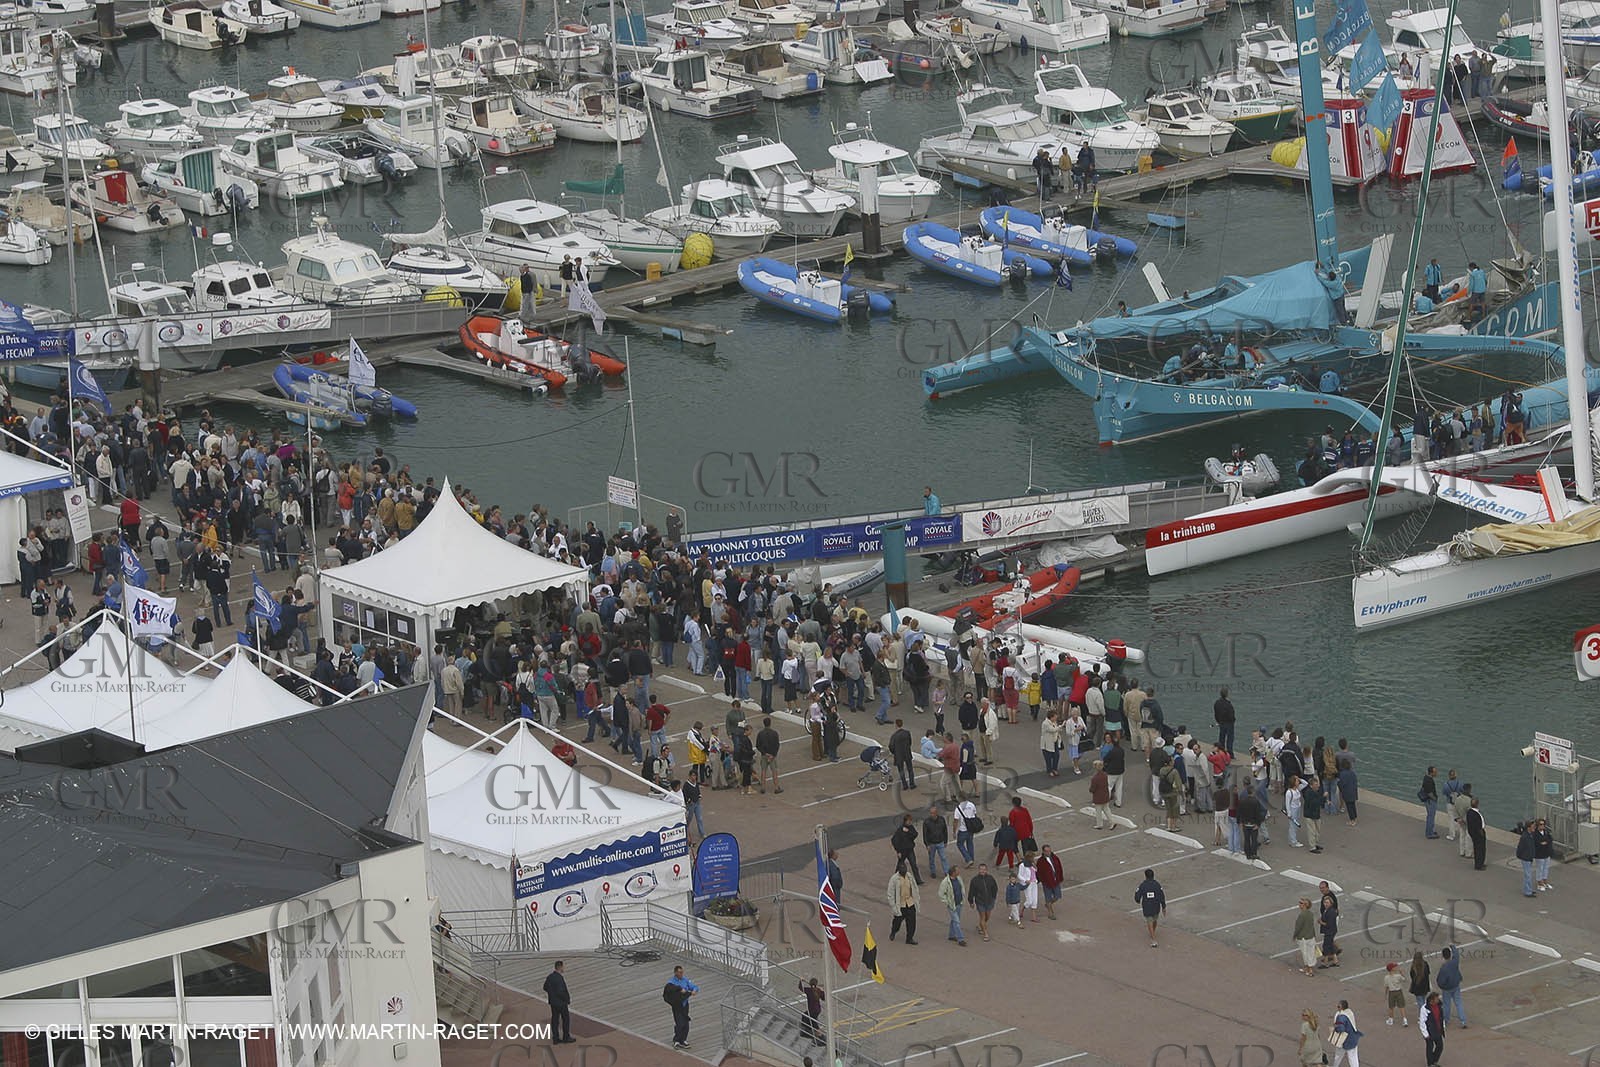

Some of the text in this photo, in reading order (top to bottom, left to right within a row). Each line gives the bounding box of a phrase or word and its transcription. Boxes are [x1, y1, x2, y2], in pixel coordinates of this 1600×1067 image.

[1404, 102, 1411, 112] 3
[1344, 110, 1352, 120] 3
[1568, 185, 1581, 311] Ethypharm
[6, 334, 20, 345] Prix
[40, 338, 68, 347] ROYALE
[6, 348, 35, 358] FECAMP
[1190, 393, 1253, 407] BELGACOM
[924, 525, 952, 535] ROYALE
[1160, 522, 1216, 542] la trinitaine
[752, 540, 758, 548] 9
[760, 534, 805, 548] TELECOM
[823, 536, 852, 546] ROYALE
[858, 540, 880, 552] PORT
[1466, 573, 1552, 600] www.ethypharm.com
[1360, 594, 1428, 616] Ethypharm
[1587, 637, 1600, 661] 3
[664, 848, 686, 858] INTERNET
[551, 844, 654, 878] www.multis-online.com
[673, 864, 680, 876] 9
[520, 884, 544, 895] INTERNET
[602, 882, 610, 894] 9
[530, 901, 538, 914] 9
